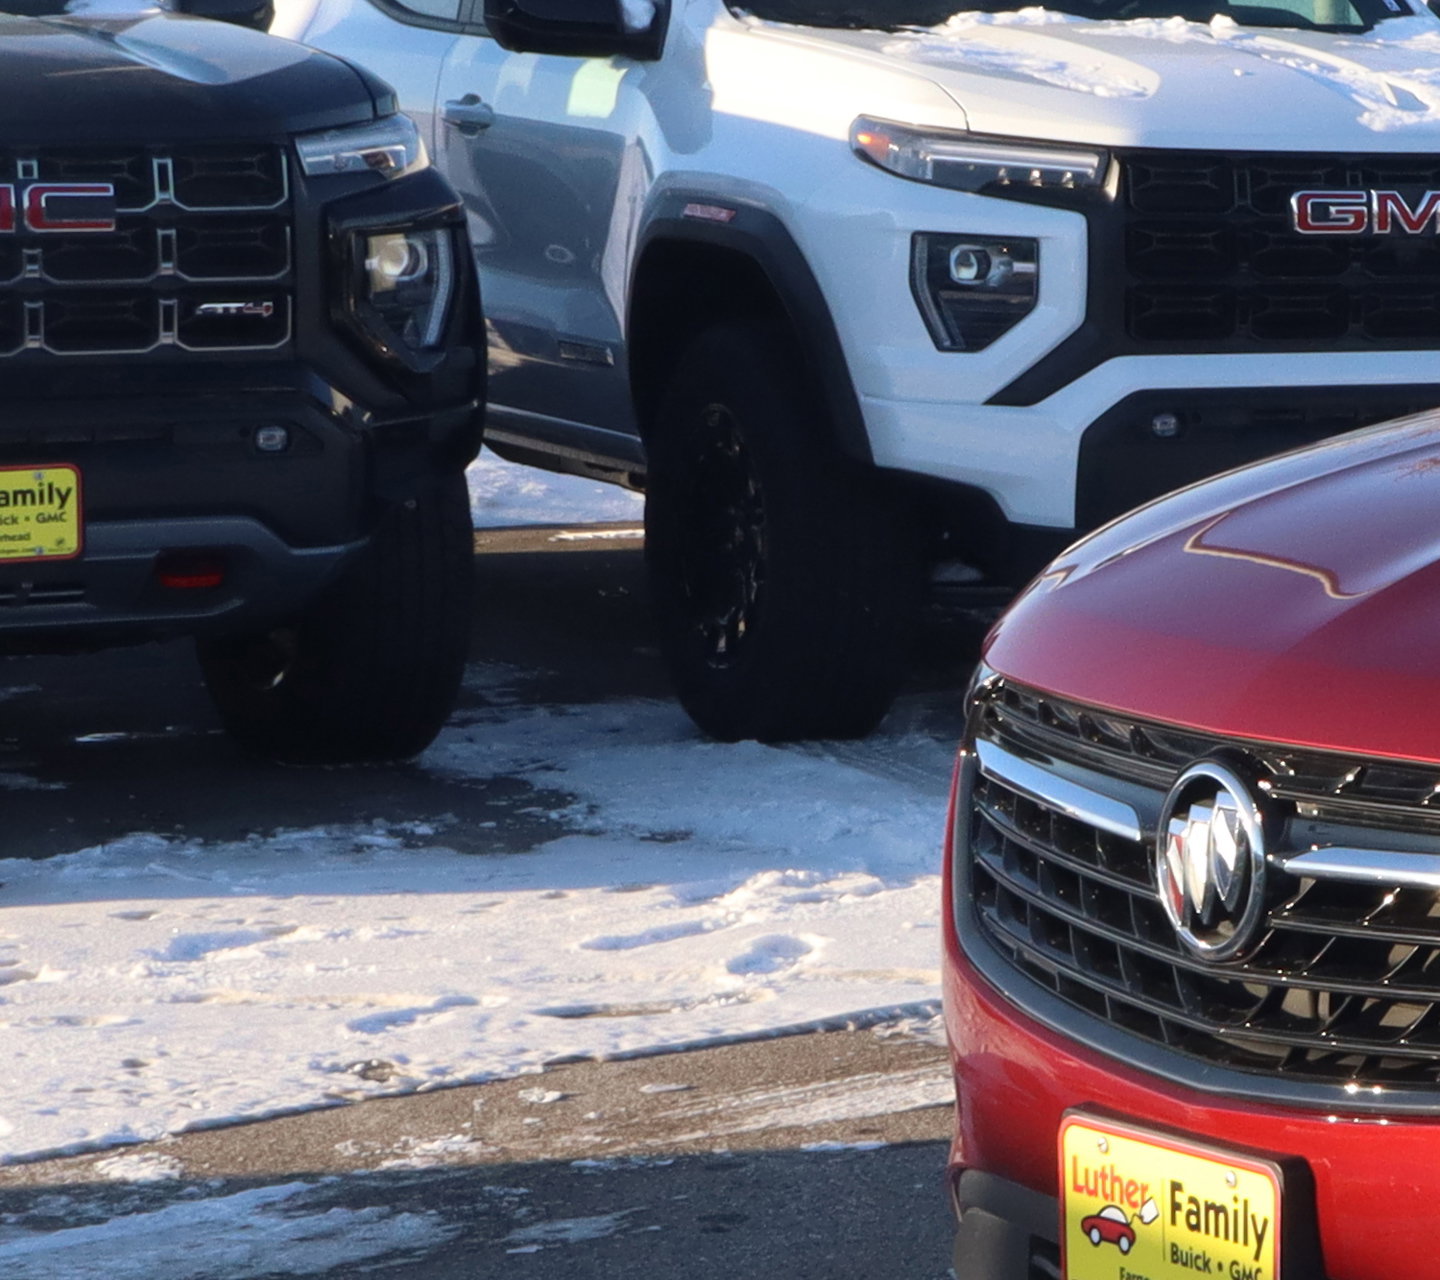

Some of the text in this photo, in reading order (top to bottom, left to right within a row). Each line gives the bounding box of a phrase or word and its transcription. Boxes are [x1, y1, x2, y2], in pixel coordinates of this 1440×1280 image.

[196, 301, 273, 317] AT4
[0, 481, 73, 510] amily
[36, 512, 67, 524] GMC
[1072, 1154, 1150, 1209] Luther
[1170, 1180, 1269, 1262] Family
[1170, 1242, 1213, 1275] Buick
